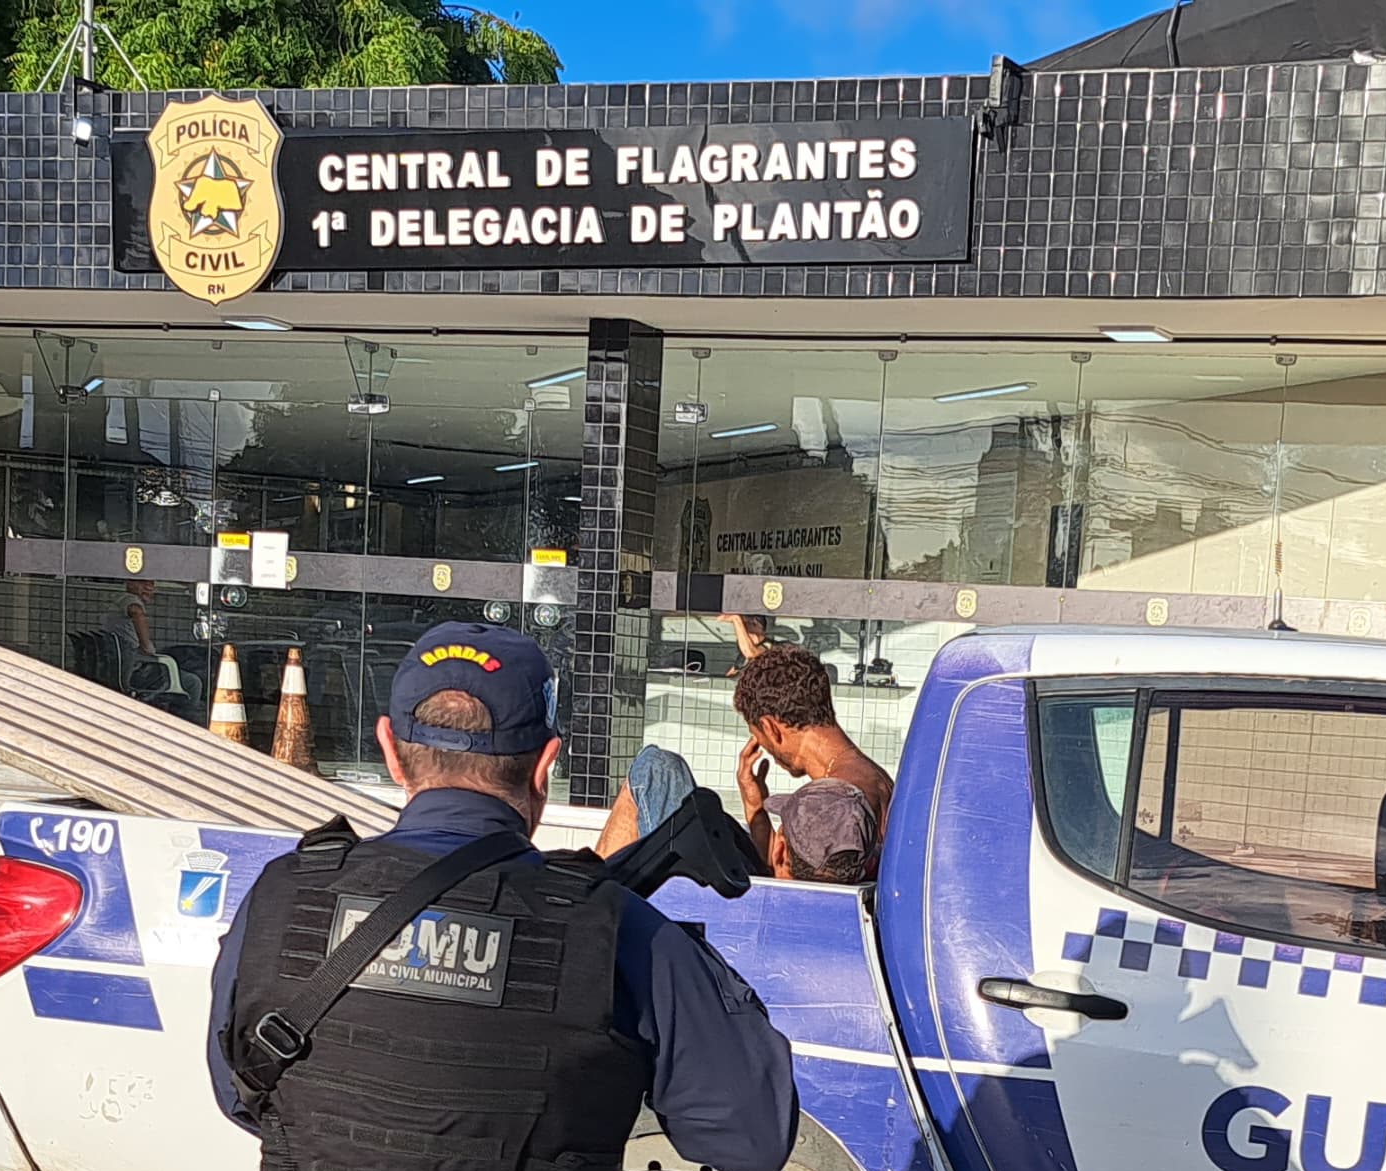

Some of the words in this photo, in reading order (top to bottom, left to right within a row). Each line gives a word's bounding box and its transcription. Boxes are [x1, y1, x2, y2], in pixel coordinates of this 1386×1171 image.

[176, 114, 250, 144] POLÍCIA
[318, 149, 511, 193] CENTRAL
[535, 148, 591, 188] DE
[616, 138, 918, 186] FLAGRANTES
[370, 206, 605, 247] DELEGACIA
[630, 204, 686, 243] DE
[712, 189, 921, 243] PLANTÃO
[184, 251, 246, 272] CIVIL
[207, 283, 226, 295] RN
[716, 531, 758, 553] CENTRAL
[760, 530, 773, 551] DE
[775, 525, 842, 549] FLAGRANTES
[420, 644, 502, 672] RONDAS
[53, 818, 115, 855] 190
[389, 963, 421, 981] CIVIL
[424, 969, 494, 992] MUNICIPAL
